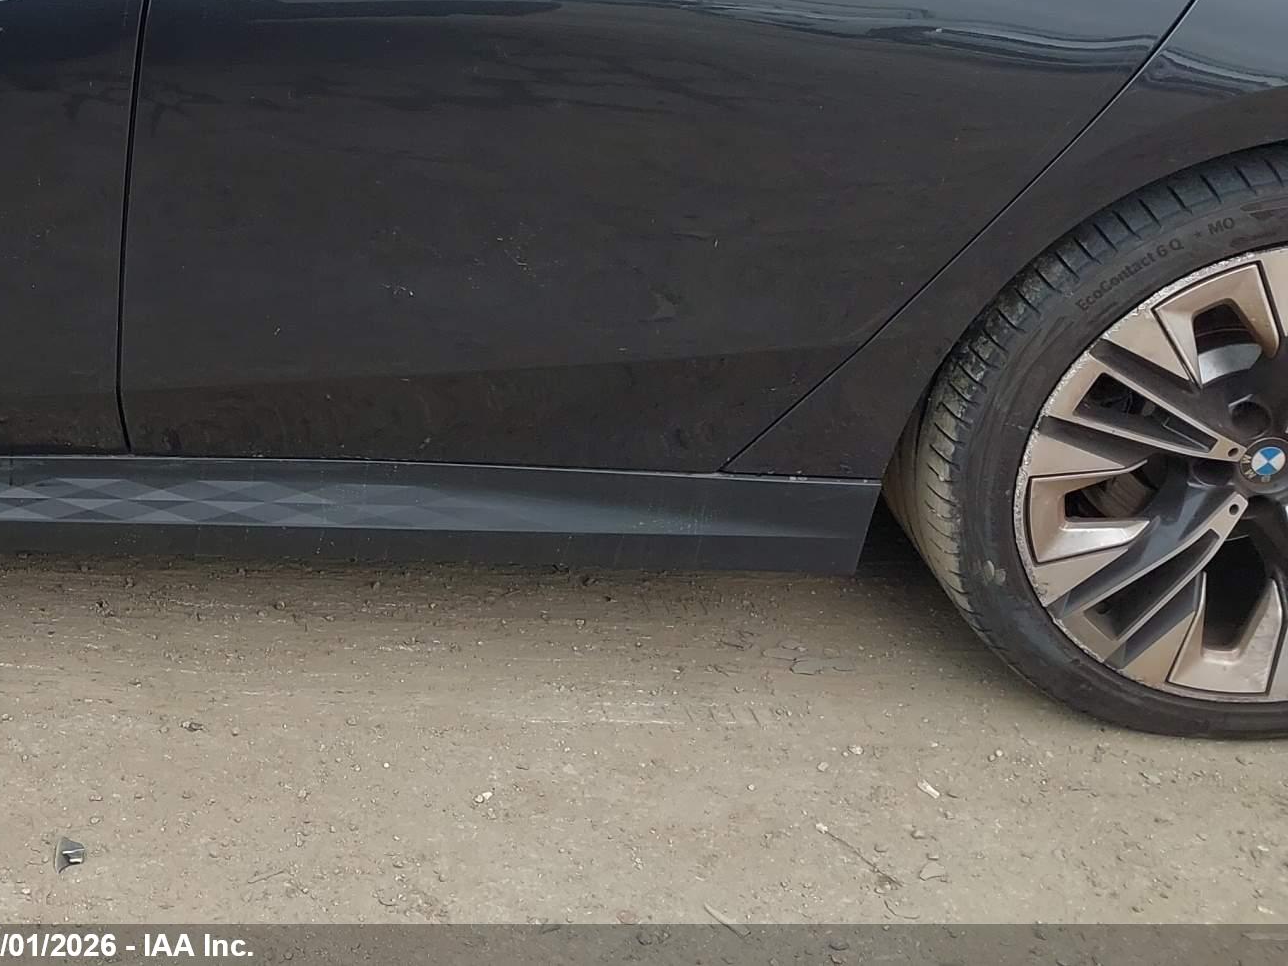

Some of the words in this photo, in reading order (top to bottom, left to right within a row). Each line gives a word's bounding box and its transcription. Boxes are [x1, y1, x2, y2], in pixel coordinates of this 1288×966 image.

[1076, 251, 1155, 312] EcoContact
[1157, 243, 1169, 258] 6
[1168, 237, 1185, 253] Q
[1208, 217, 1236, 236] MO
